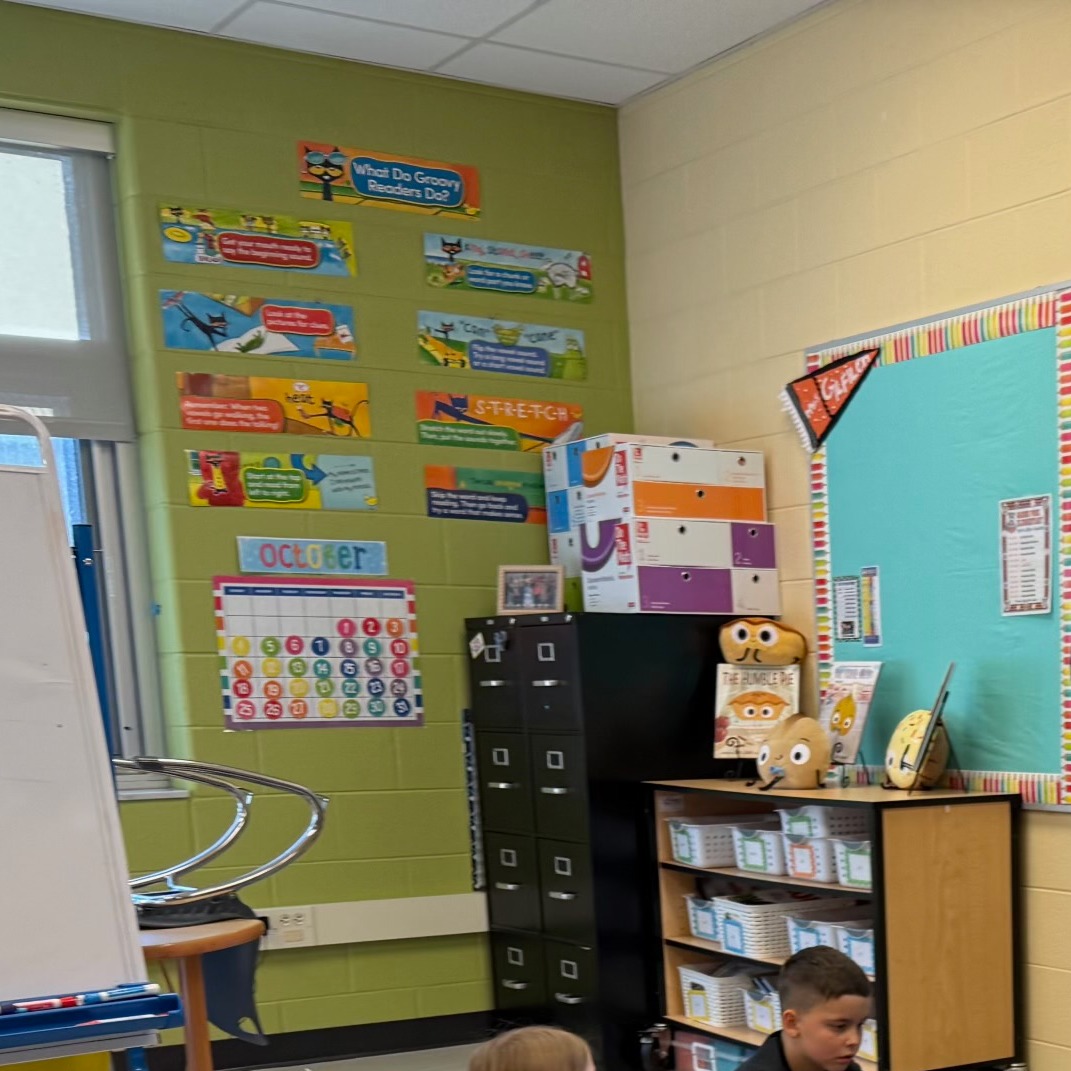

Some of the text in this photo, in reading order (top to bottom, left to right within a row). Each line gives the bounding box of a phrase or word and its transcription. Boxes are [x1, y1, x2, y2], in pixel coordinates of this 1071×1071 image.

[352, 162, 460, 192] What Do Groovy
[368, 179, 450, 201] Readers Do?
[474, 400, 569, 422] S-T-R-E-T-C-H
[368, 621, 375, 631] 2
[392, 622, 398, 631] 3
[266, 640, 406, 654] 5 6 7 8 9 10
[292, 663, 303, 673] 13
[317, 664, 328, 674] 14
[344, 664, 355, 674] 15
[370, 660, 381, 671] 16
[396, 664, 405, 673] 17
[722, 671, 794, 686] THE HUMBLE PIE
[238, 684, 248, 694] 18
[268, 685, 279, 696] 19
[320, 682, 330, 692] 21
[345, 683, 357, 694] 22
[370, 682, 382, 693] 23
[393, 684, 405, 694] 24
[239, 705, 254, 716] 25
[267, 704, 280, 716] 26
[292, 704, 304, 714] 27
[370, 702, 383, 712] 30
[396, 702, 408, 713] 31
